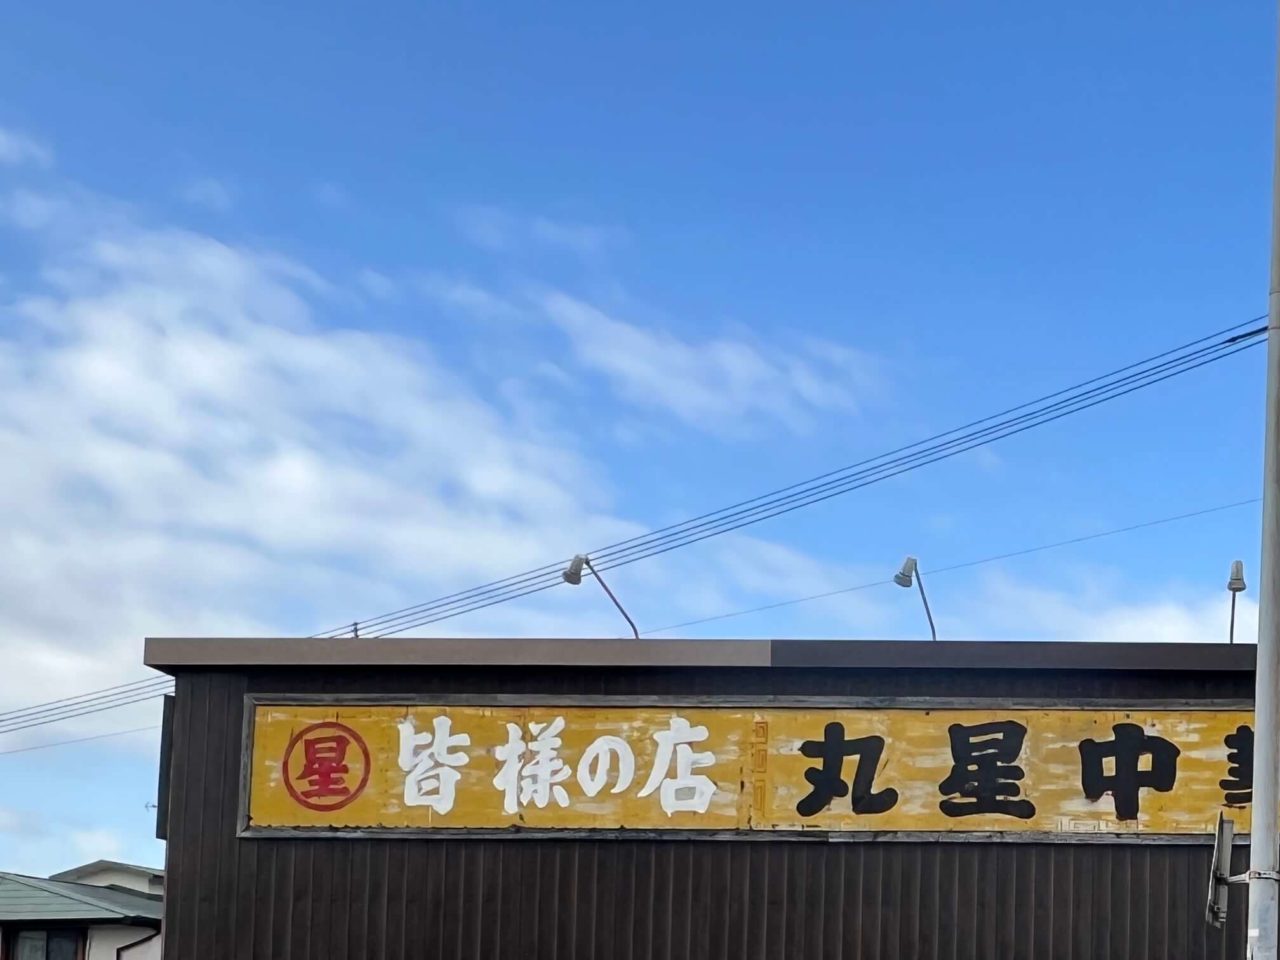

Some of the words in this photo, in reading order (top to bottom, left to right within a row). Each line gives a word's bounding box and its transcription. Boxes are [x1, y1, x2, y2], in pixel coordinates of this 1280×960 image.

[296, 734, 353, 799] 星
[398, 715, 717, 818] 皆様の店
